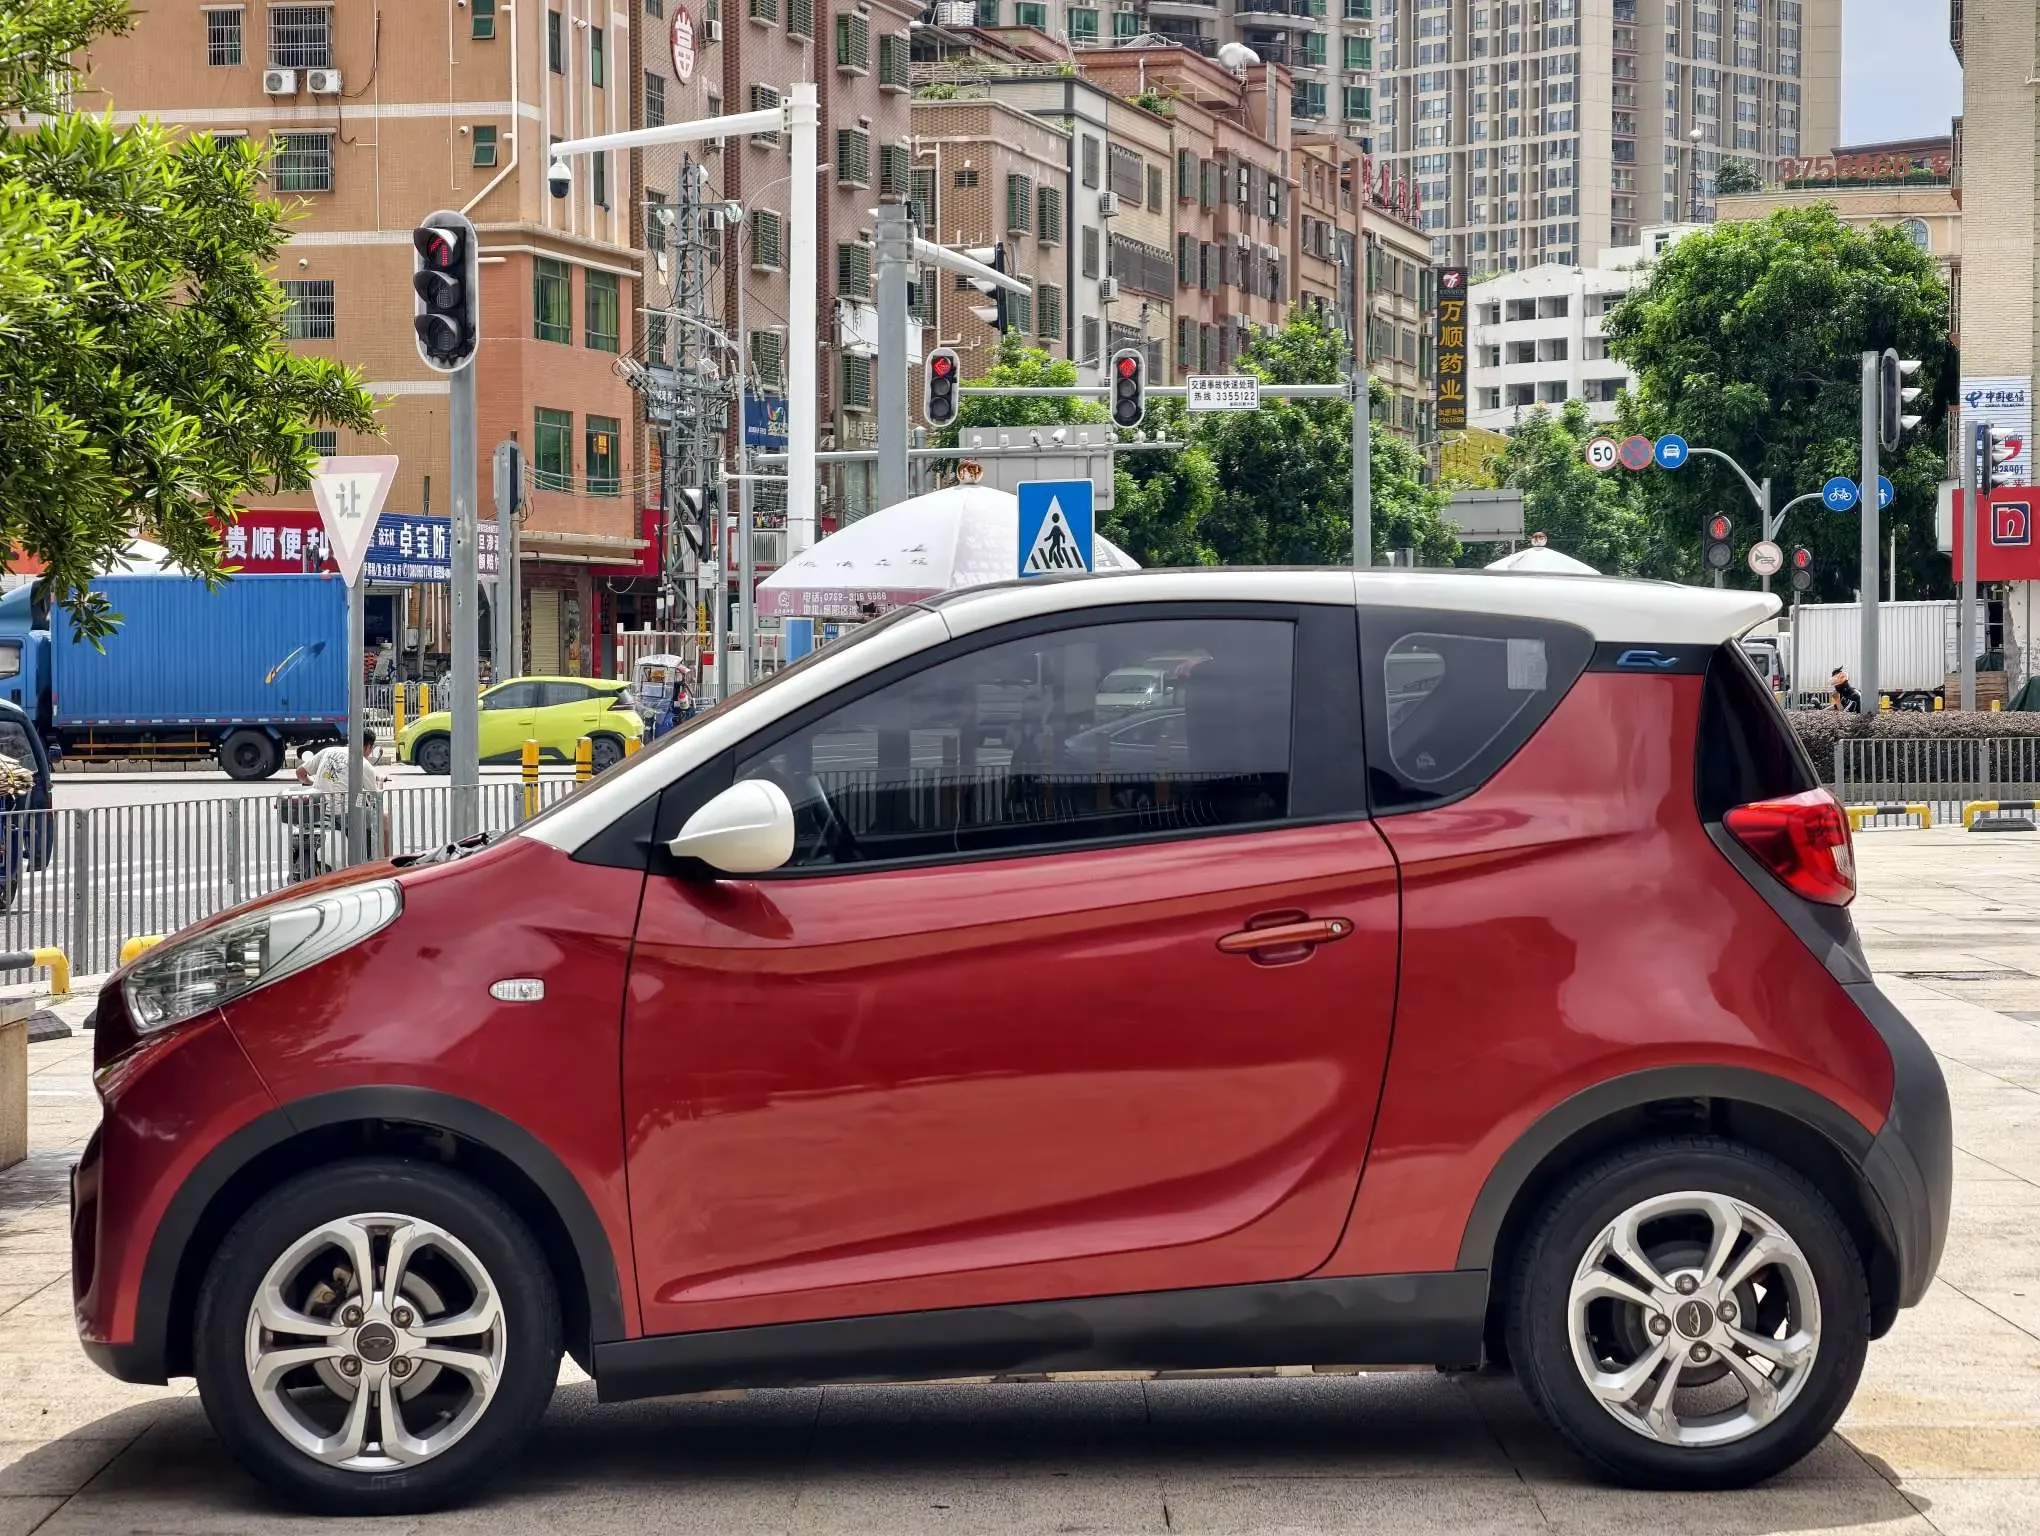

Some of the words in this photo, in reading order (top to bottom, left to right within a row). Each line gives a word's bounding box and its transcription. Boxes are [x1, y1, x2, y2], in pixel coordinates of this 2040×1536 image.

[1439, 300, 1465, 401] 万顺药业
[1191, 379, 1255, 390] 交通事故快速处理
[1216, 391, 1256, 401] 3355122
[1985, 390, 2025, 403] 中国电信
[1593, 446, 1613, 462] 50
[335, 480, 361, 520] 让
[399, 522, 451, 559] 卓宝防
